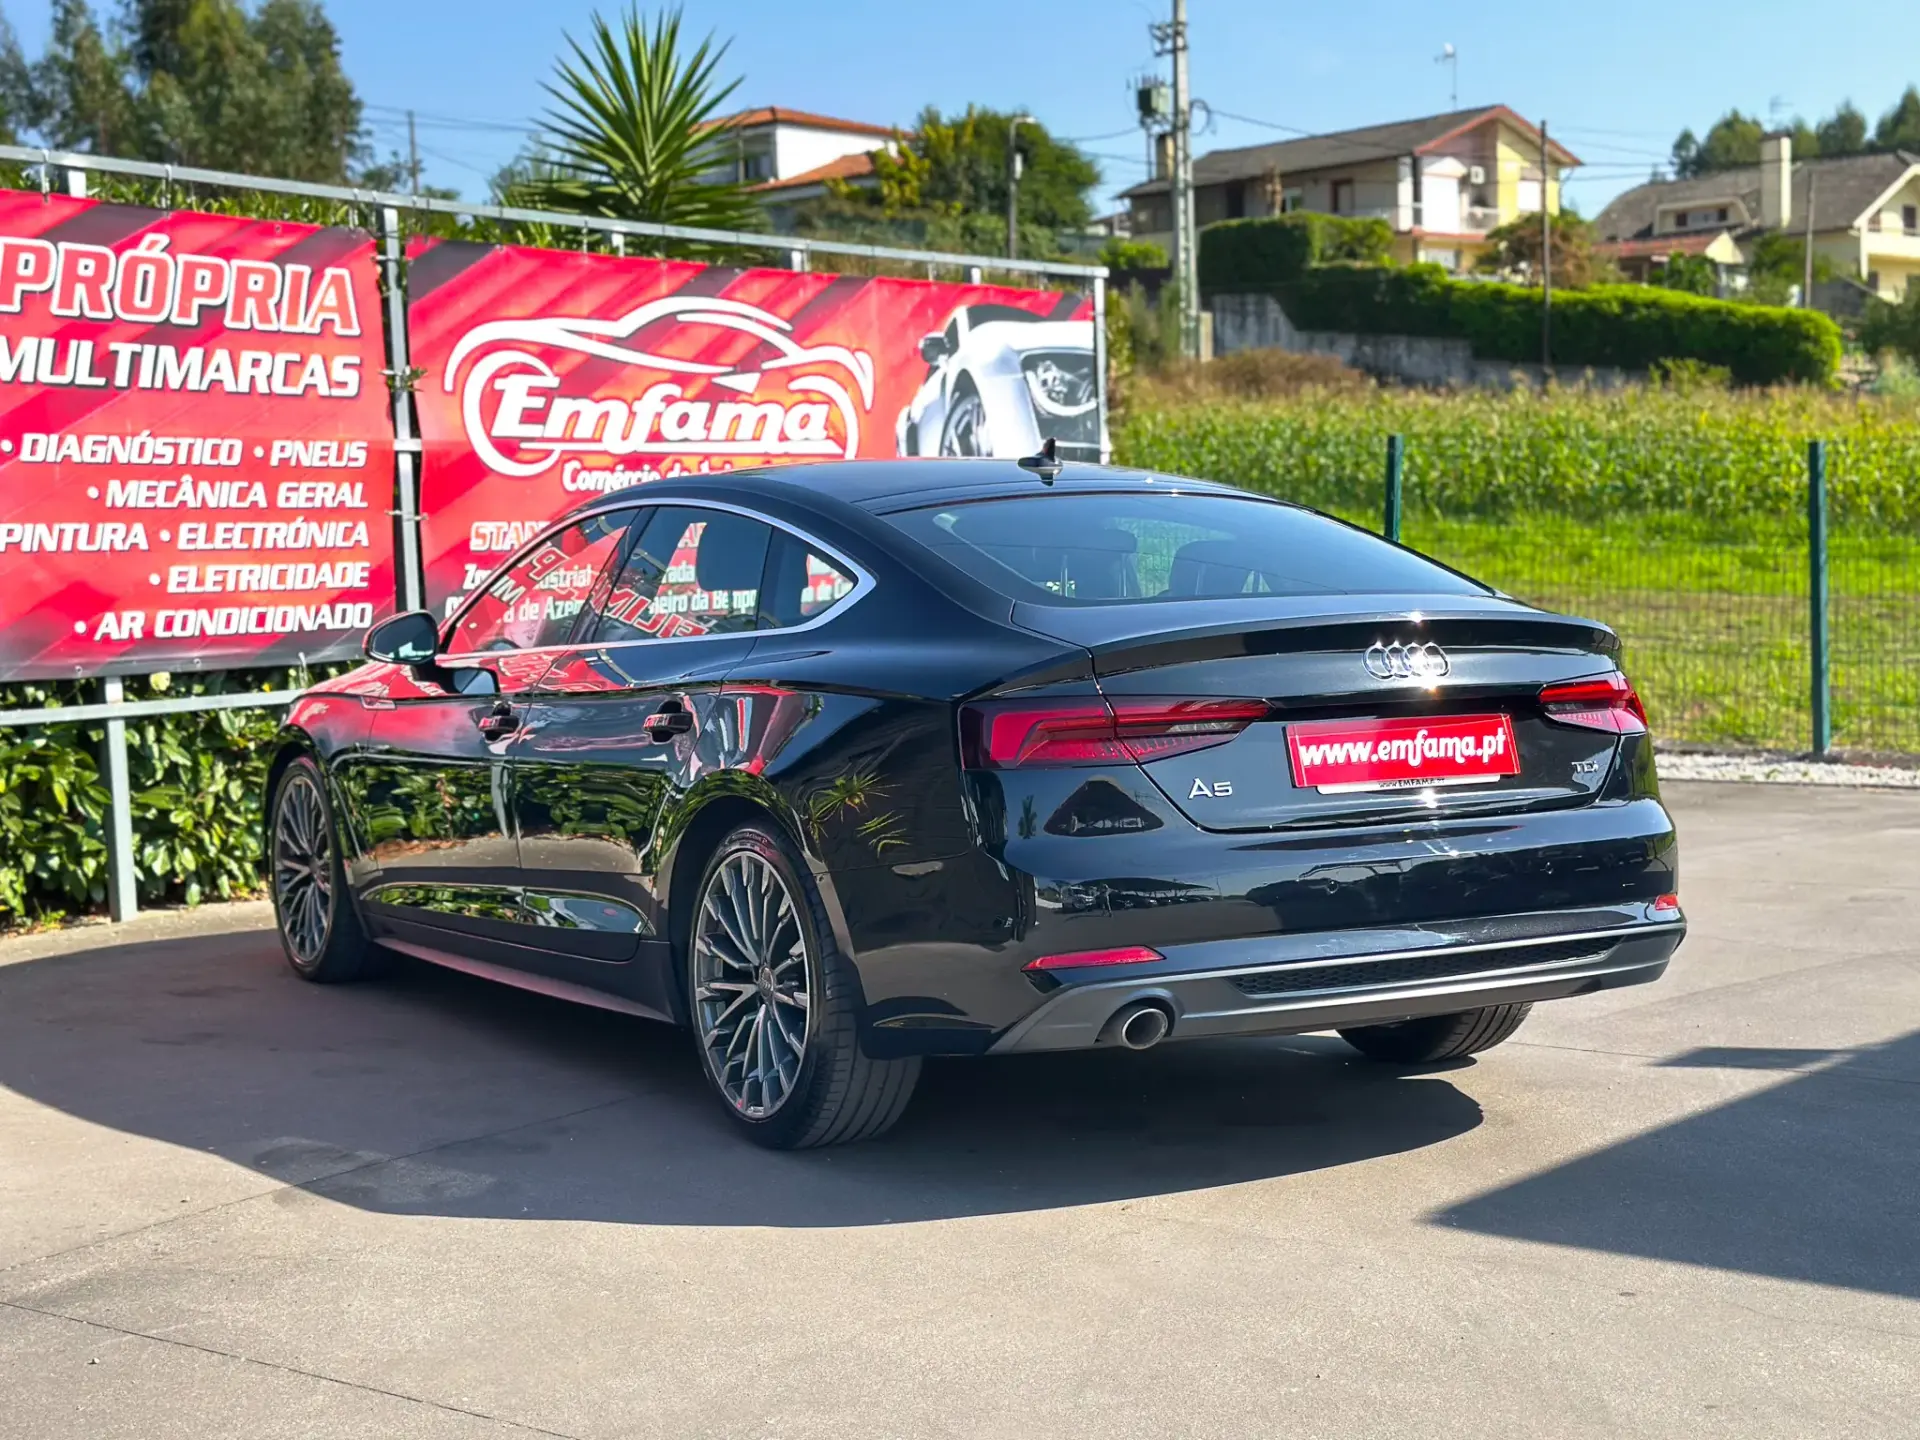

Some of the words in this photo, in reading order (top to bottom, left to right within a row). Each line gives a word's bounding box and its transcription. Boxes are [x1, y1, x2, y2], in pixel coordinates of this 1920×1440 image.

[0, 233, 361, 335] PRÓPRIA
[0, 335, 361, 397] MULTIMARCAS
[490, 373, 830, 454] Emfama
[19, 431, 243, 466] DIAGNÓSTICO
[270, 440, 368, 468] PNEUS
[106, 474, 268, 509] MECÂNICA
[277, 481, 368, 508] GERAL
[0, 522, 149, 552] PINTURA
[177, 517, 369, 550] ELECTRÓNICA
[167, 561, 371, 594] ELETRICIDADE
[519, 598, 540, 621] de
[691, 588, 709, 611] da
[94, 611, 145, 641] AR
[154, 603, 373, 638] CONDICIONADO
[1300, 728, 1506, 768] www.emfama.pt
[1188, 777, 1233, 800] A5
